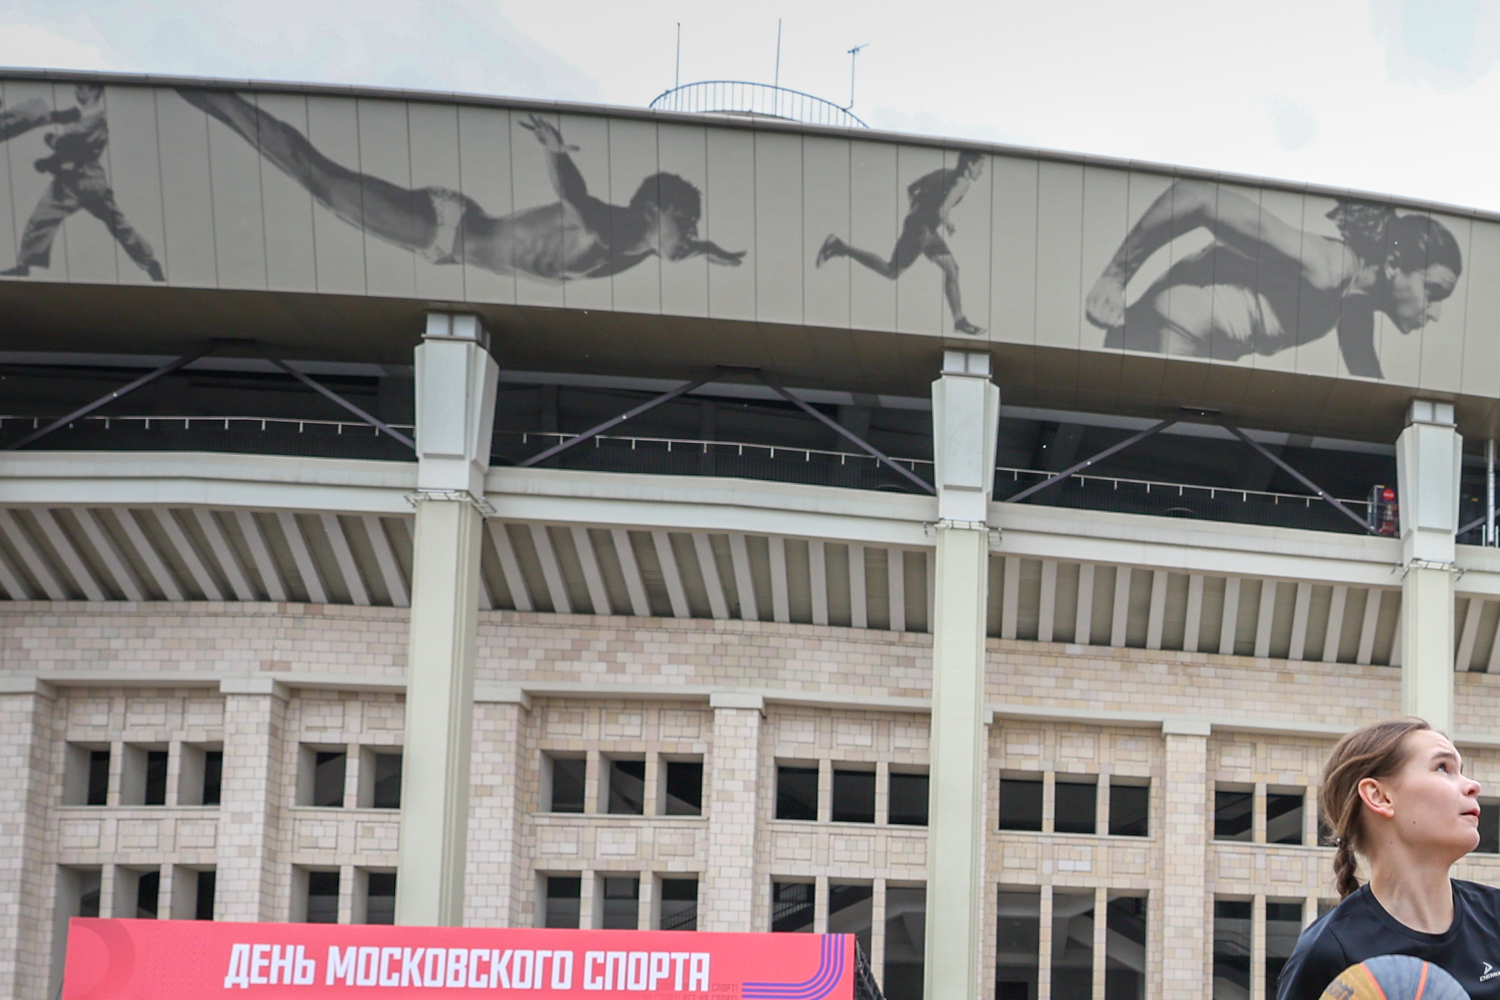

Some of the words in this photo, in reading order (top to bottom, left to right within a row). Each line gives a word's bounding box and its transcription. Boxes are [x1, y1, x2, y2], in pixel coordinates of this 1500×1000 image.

[223, 943, 316, 989] ДЕНЬ
[325, 945, 574, 990] МОСКОВСКОГО
[583, 950, 711, 992] СПОРТА
